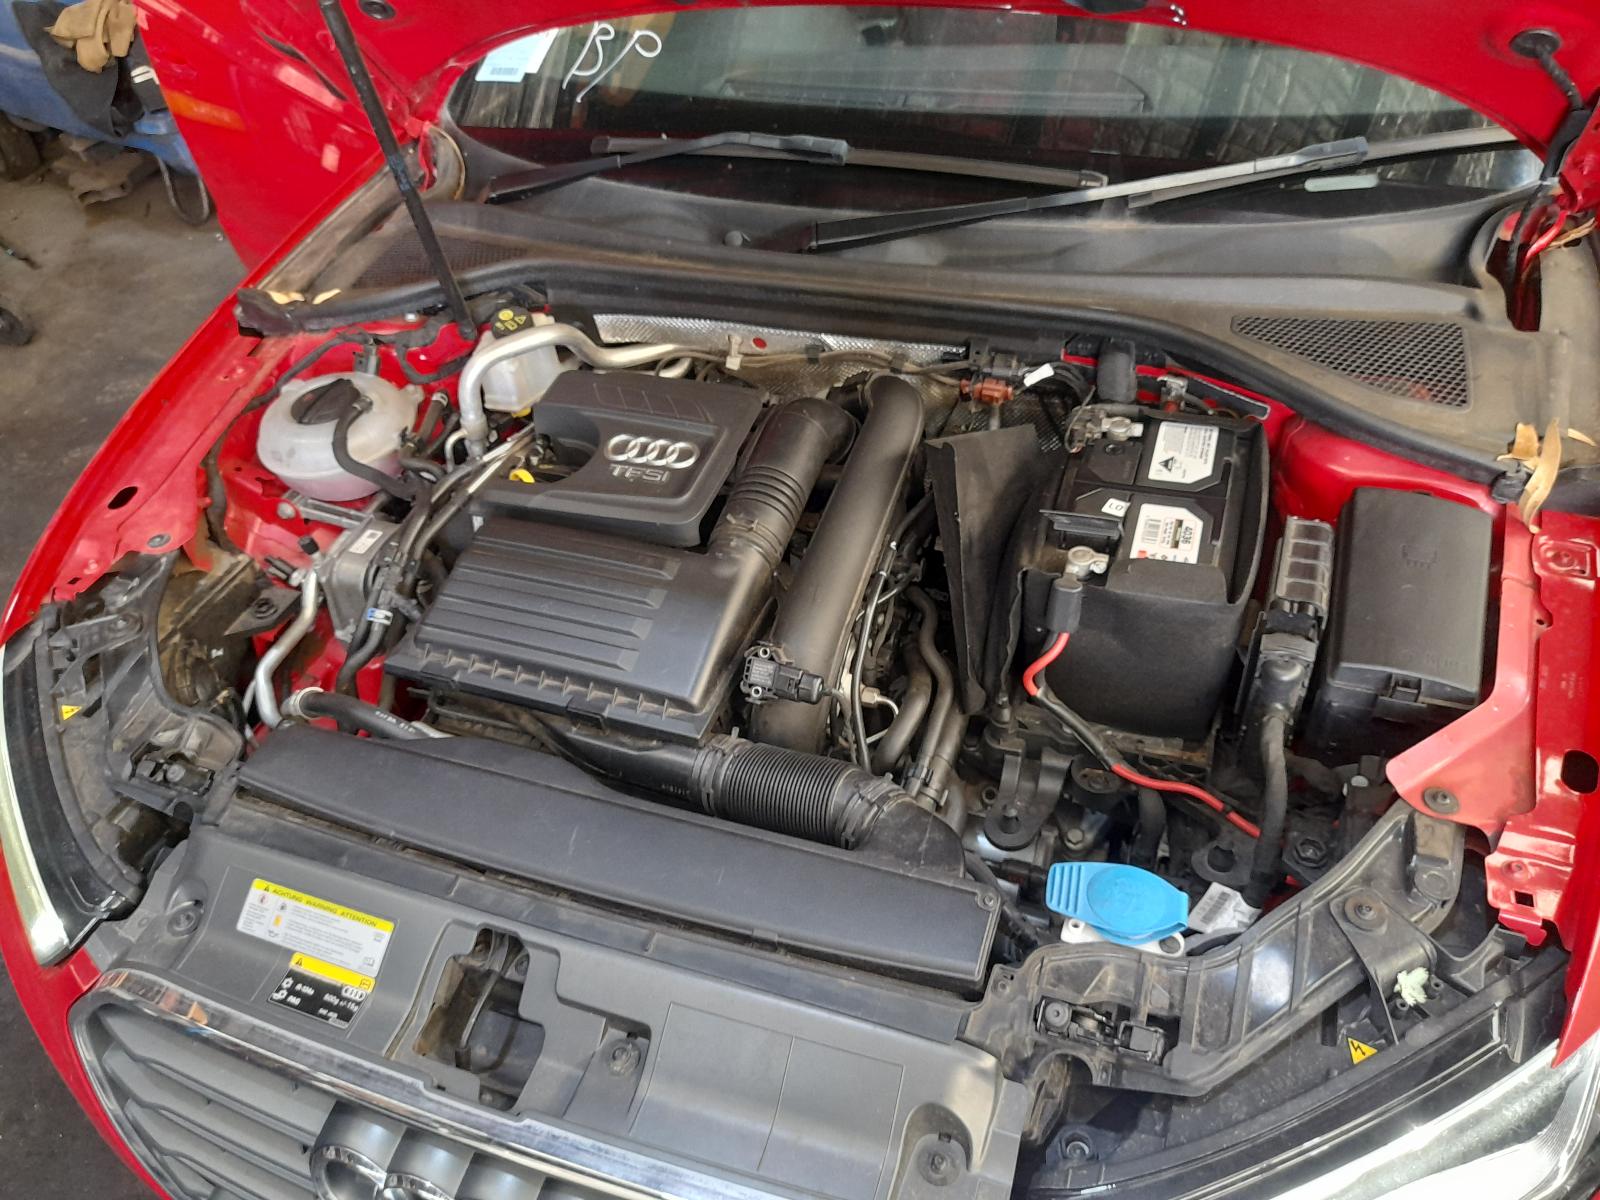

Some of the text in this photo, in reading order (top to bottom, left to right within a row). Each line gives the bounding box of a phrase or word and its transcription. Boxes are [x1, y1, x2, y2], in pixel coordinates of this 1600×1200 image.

[610, 463, 671, 482] TFSI
[272, 888, 303, 903] ACHTUNG
[305, 896, 338, 914] WARNING
[340, 909, 377, 928] ATTENTION
